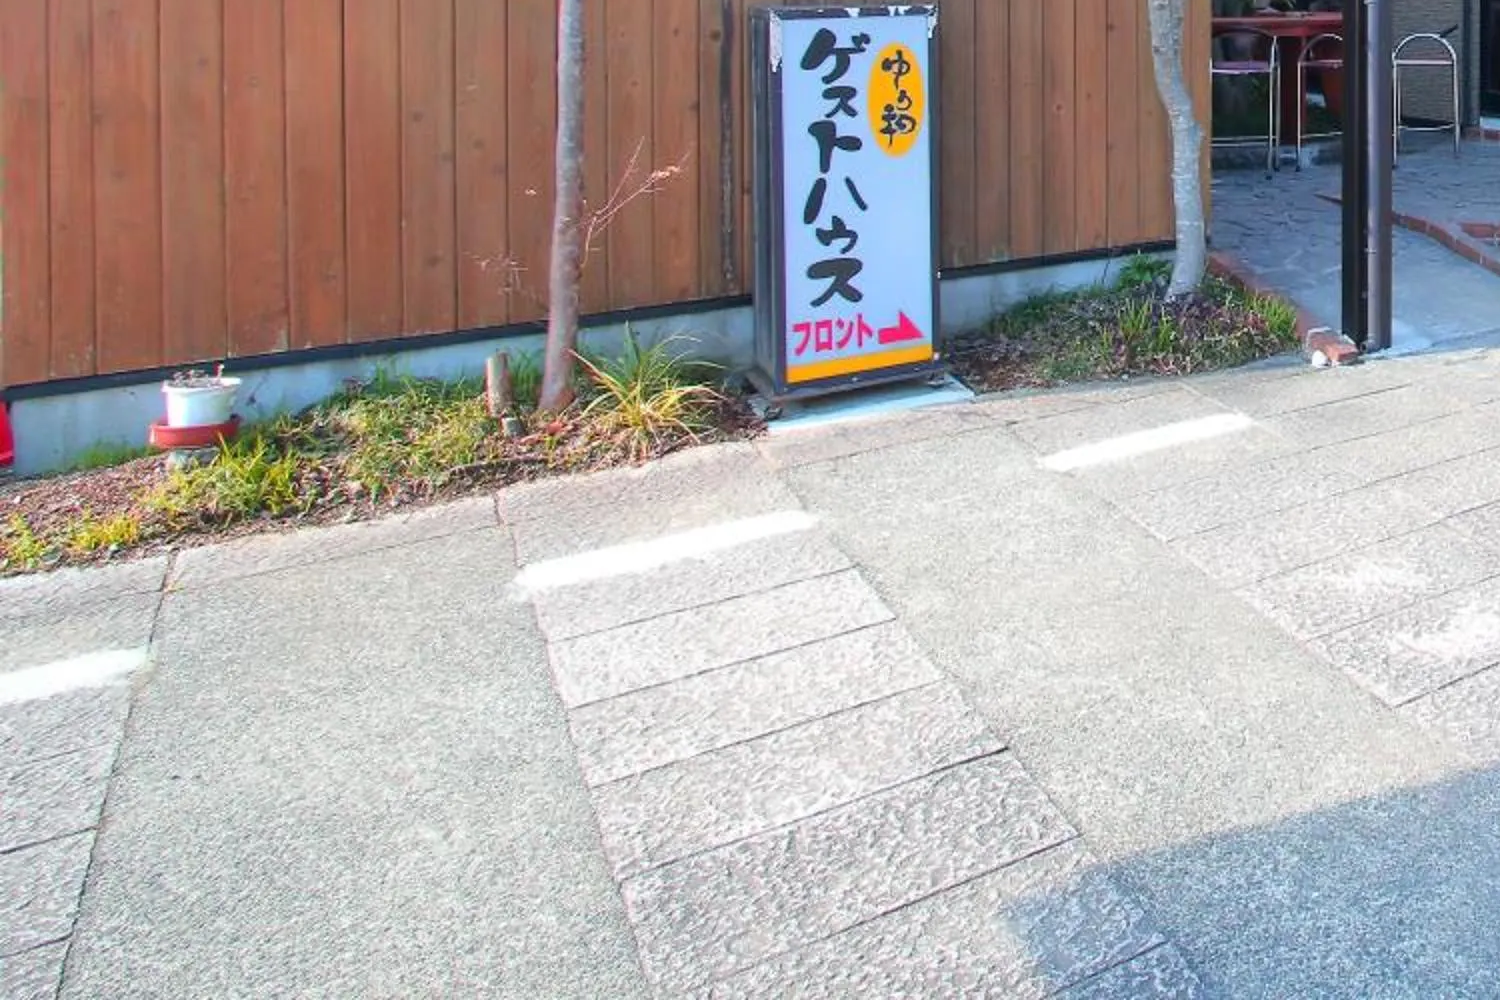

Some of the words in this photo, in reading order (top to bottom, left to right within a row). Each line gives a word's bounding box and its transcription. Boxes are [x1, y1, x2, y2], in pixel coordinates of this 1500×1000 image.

[800, 27, 871, 308] ゲストハウス
[793, 313, 873, 356] フロント
